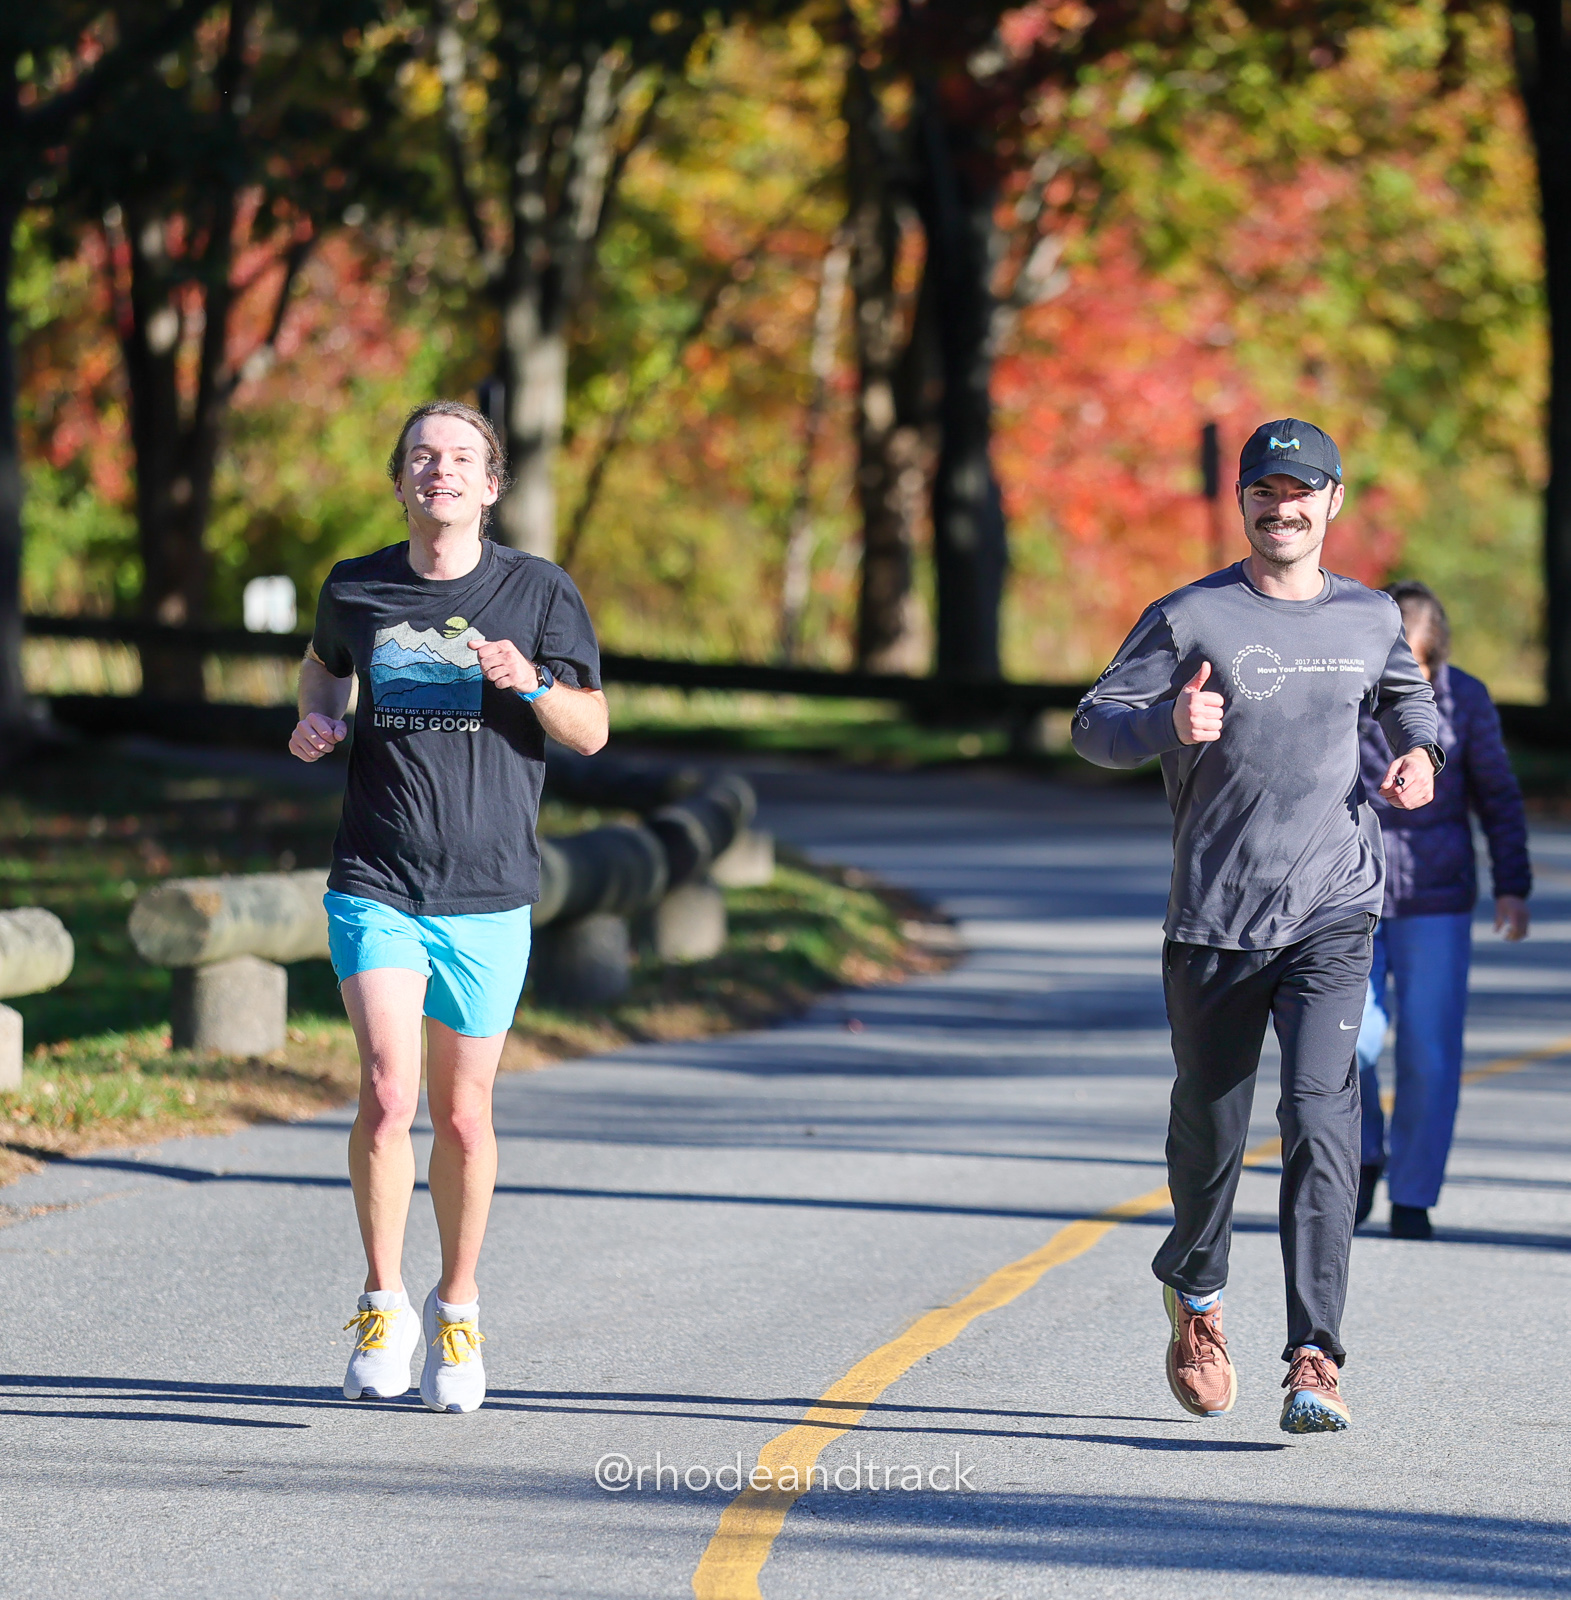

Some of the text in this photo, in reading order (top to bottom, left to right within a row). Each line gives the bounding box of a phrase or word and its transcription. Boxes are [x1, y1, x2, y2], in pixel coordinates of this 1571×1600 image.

[1294, 658, 1311, 666] 2017
[1298, 665, 1325, 673] Feeties
[409, 716, 425, 730] IS
